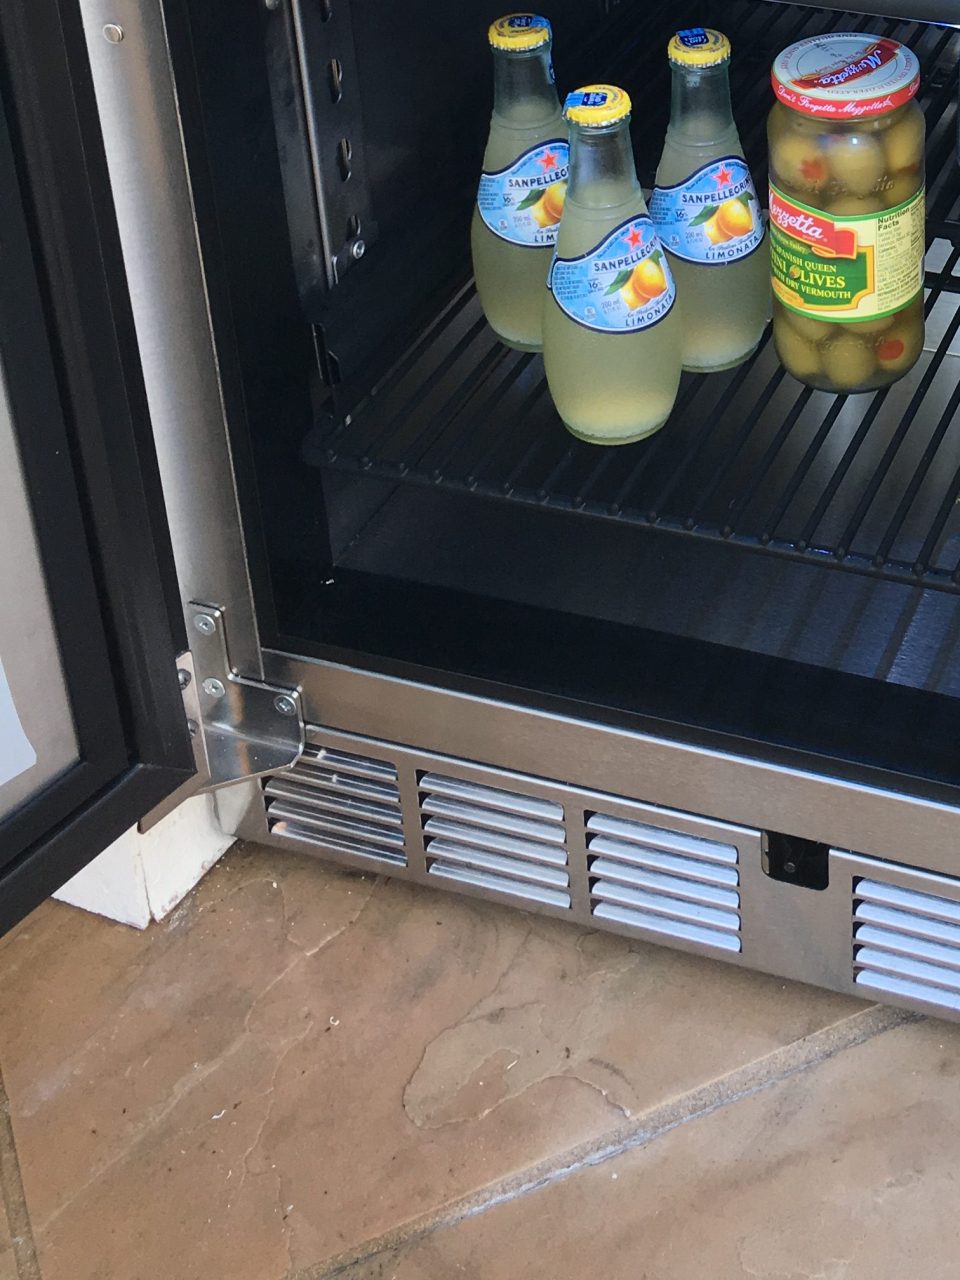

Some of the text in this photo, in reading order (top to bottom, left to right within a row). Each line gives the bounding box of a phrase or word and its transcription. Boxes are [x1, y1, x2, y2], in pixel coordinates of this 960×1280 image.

[819, 50, 882, 85] Mezzetta
[778, 84, 884, 116] Don't Forgetta Mezzetta
[508, 165, 569, 188] SANPELLEG
[682, 175, 751, 204] SANPELLEGRIN
[878, 206, 910, 224] Nutrition
[878, 220, 899, 231] Facts
[594, 236, 658, 272] SANPELLEGRI
[706, 236, 758, 259] LIMONATA
[771, 248, 786, 272] TINI
[804, 260, 836, 273] QUEEN
[786, 277, 800, 290] DRY
[801, 285, 851, 299] VERMOUTH
[625, 294, 673, 327] LIMONATA
